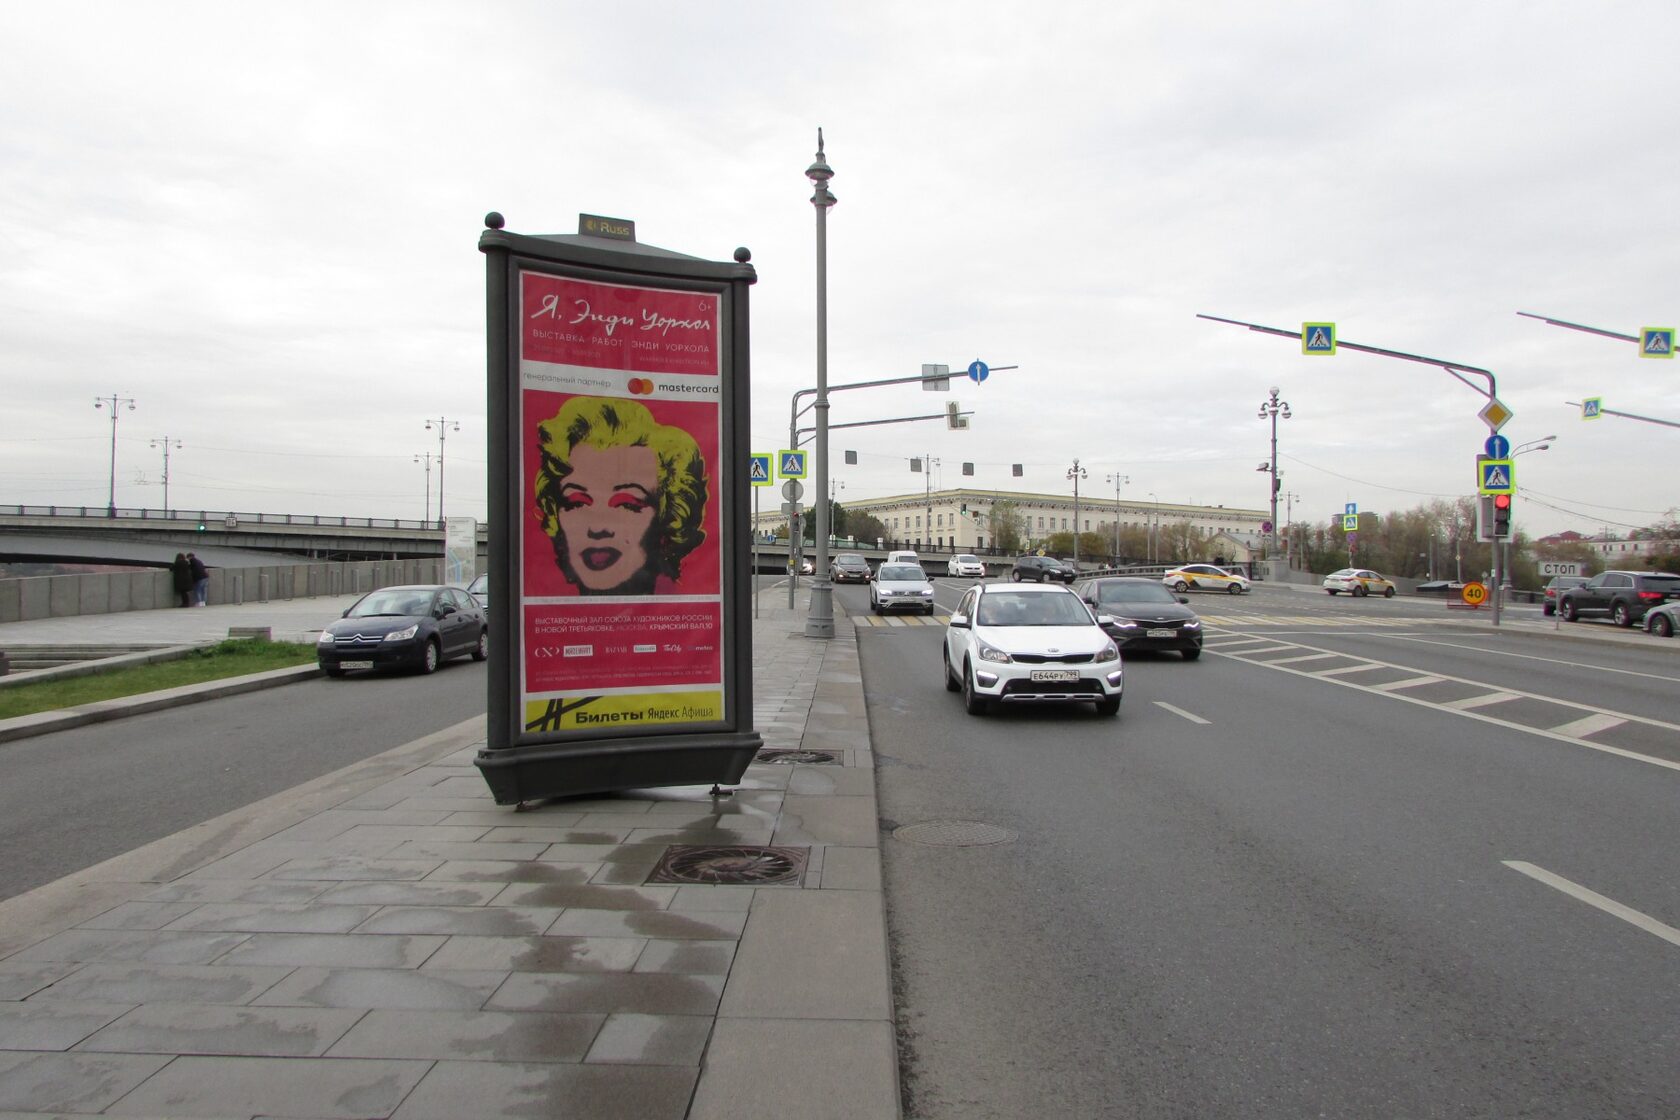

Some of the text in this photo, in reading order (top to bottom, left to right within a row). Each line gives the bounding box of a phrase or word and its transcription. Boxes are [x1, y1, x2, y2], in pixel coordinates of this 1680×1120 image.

[600, 221, 630, 236] Russ
[698, 300, 712, 312] 6+
[569, 299, 634, 336] Энди
[532, 329, 710, 353] ВЫСТАВКА РАБОТ ЭНДИ УОРХОЛА
[523, 371, 576, 385] генеральный
[658, 383, 719, 394] mastercard
[1544, 564, 1576, 574] СТОП
[1466, 588, 1482, 600] 40
[535, 614, 713, 625] ВЫСТАВОЧНЫЙ ЗАЛ СОЮЗА ХУДОЖНИКОВ РОССИИ
[535, 626, 540, 634] В
[541, 625, 568, 634] НОВОЙ
[649, 622, 689, 631] КРЫМСКИЙ
[575, 704, 714, 724] Билеты Яндекс Афиша
